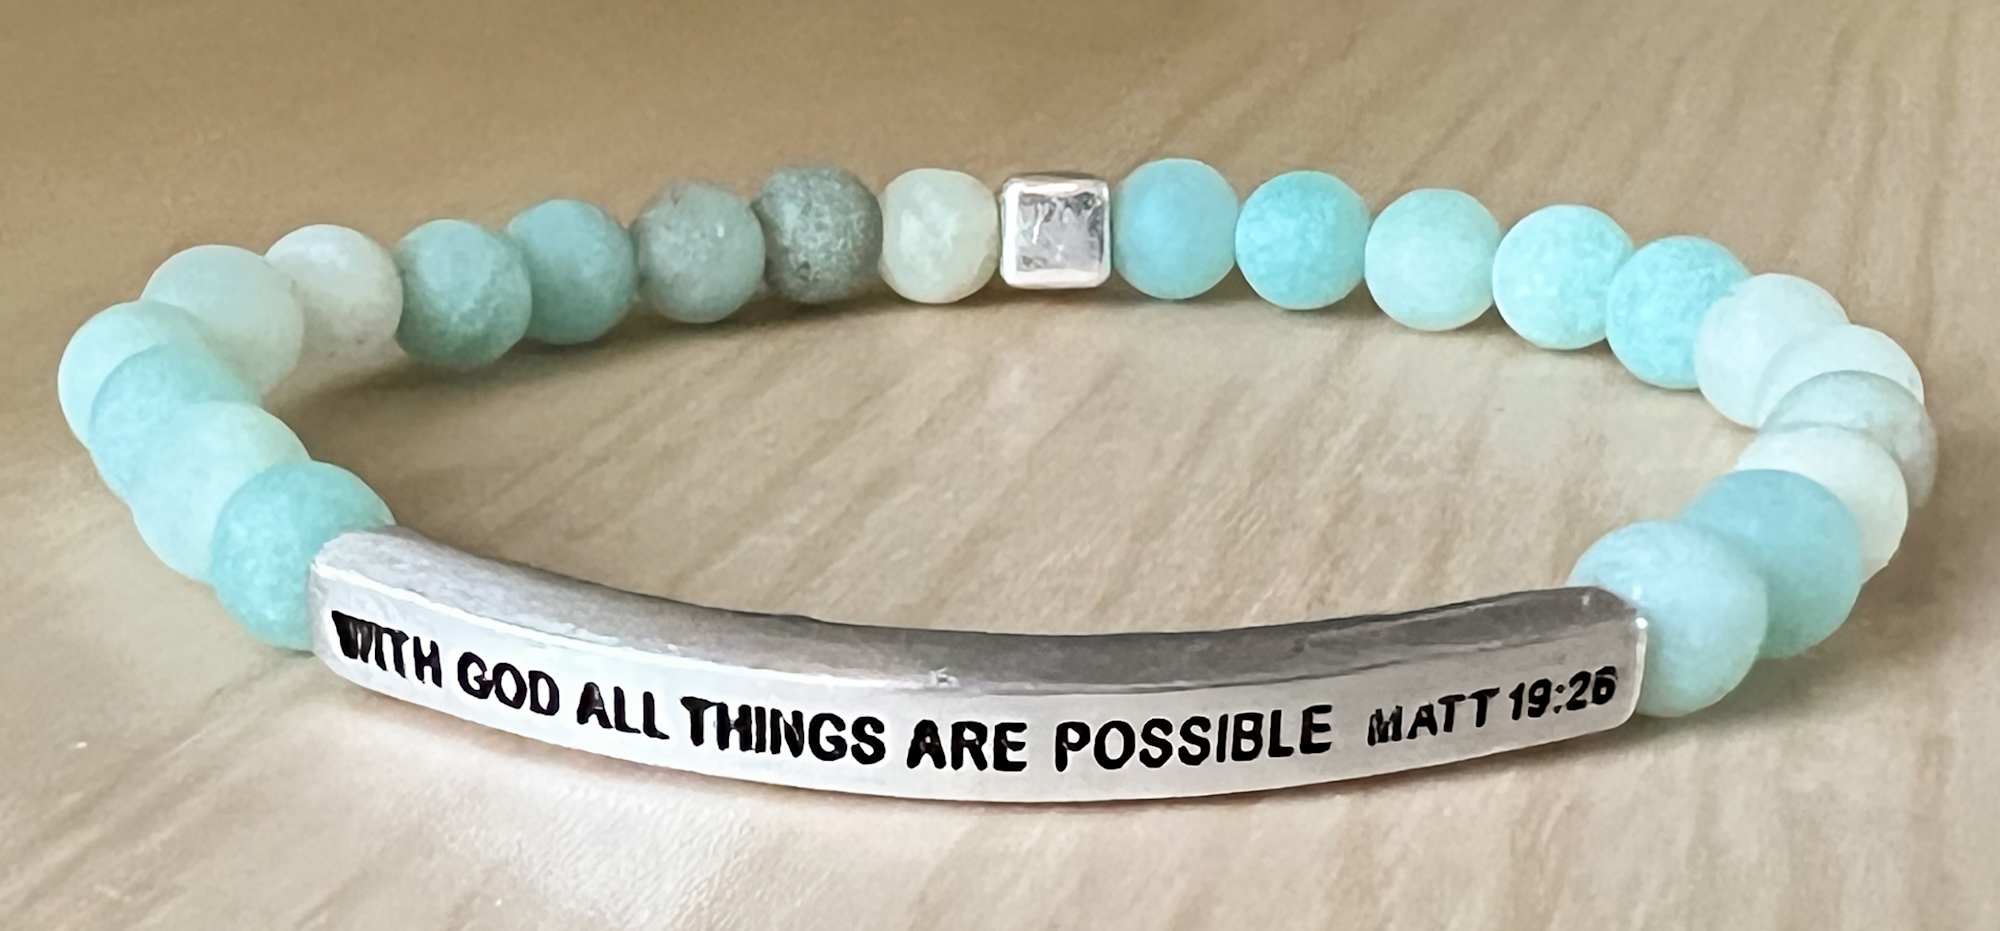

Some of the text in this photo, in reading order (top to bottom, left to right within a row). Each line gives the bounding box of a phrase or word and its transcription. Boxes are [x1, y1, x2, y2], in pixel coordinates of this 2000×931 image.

[331, 610, 1618, 772] WITH GOD ALL THINGS ARE POSSIBLE MATT 19:26
